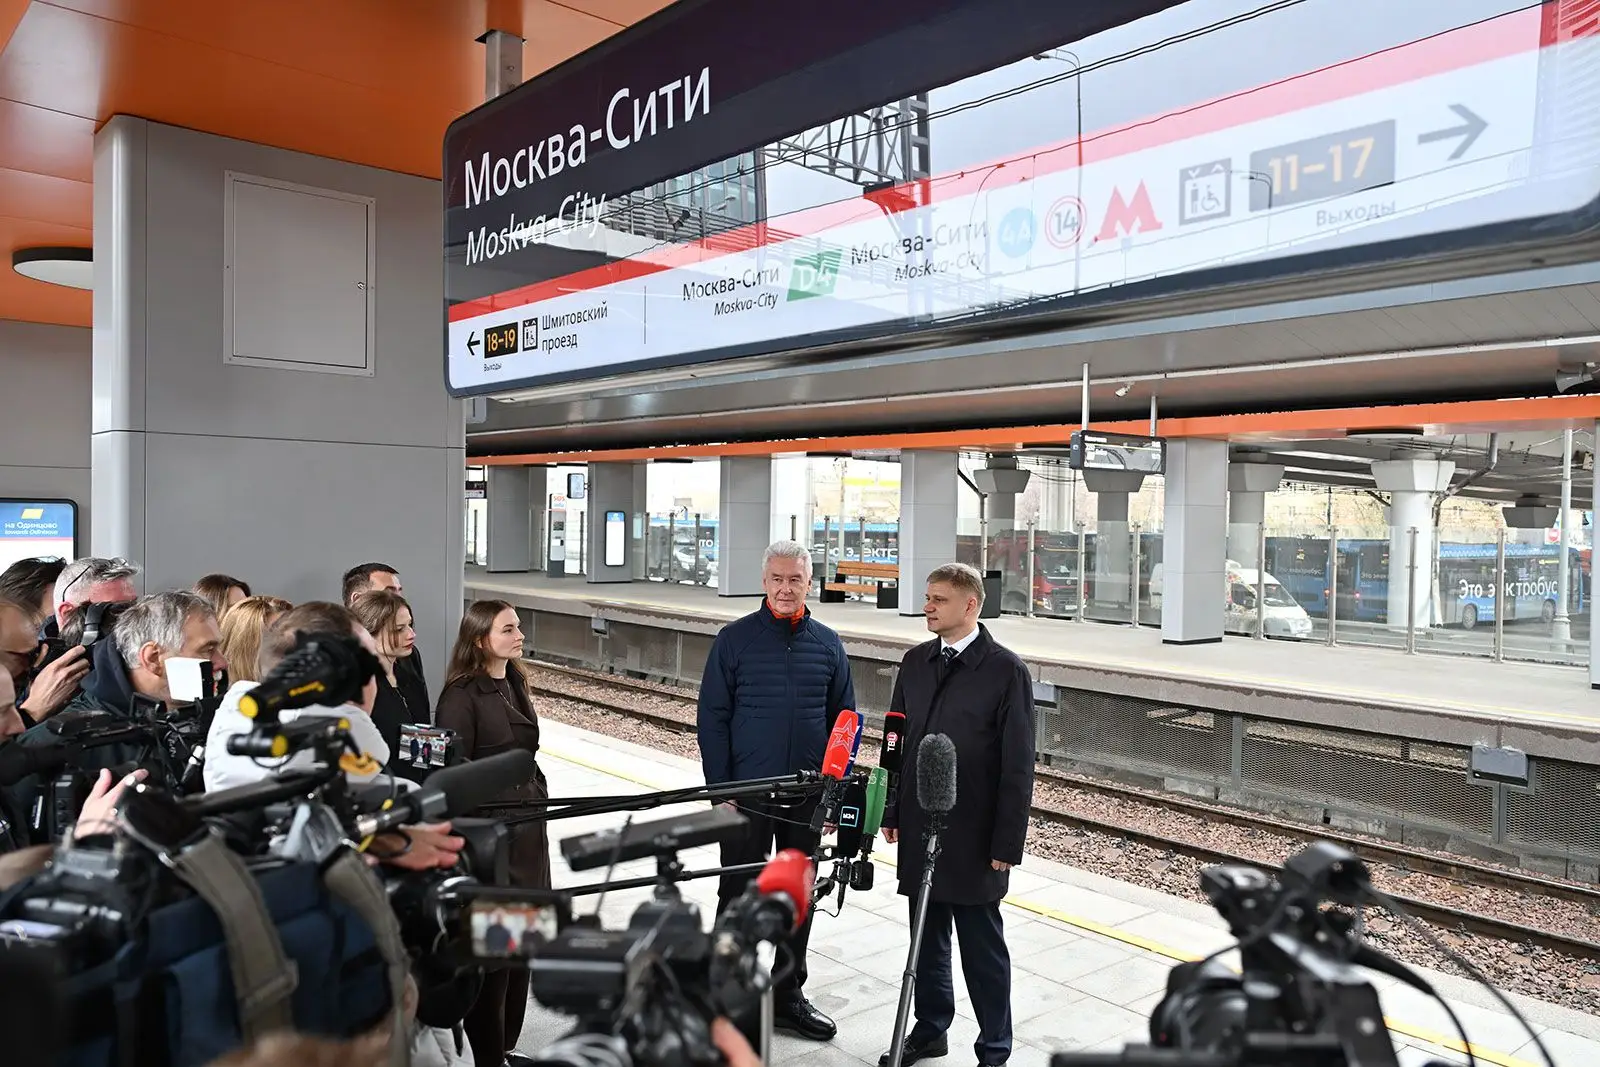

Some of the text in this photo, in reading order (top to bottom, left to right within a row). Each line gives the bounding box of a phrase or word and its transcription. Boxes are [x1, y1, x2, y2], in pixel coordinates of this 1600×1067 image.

[465, 66, 710, 209] Москва-Сити
[466, 191, 606, 266] Moskva-City
[1055, 209, 1078, 235] 14
[1316, 201, 1396, 227] Выходы
[851, 220, 987, 265] Москва-Сити
[796, 263, 833, 292] D4
[894, 250, 986, 281] Moskva-City
[682, 266, 780, 301] Москва-Сити
[541, 300, 608, 331] Шмитовский
[713, 293, 779, 316] Moskva-City
[541, 333, 578, 355] проезд
[483, 363, 502, 372] Выходы
[1458, 576, 1558, 599] Это эктробус
